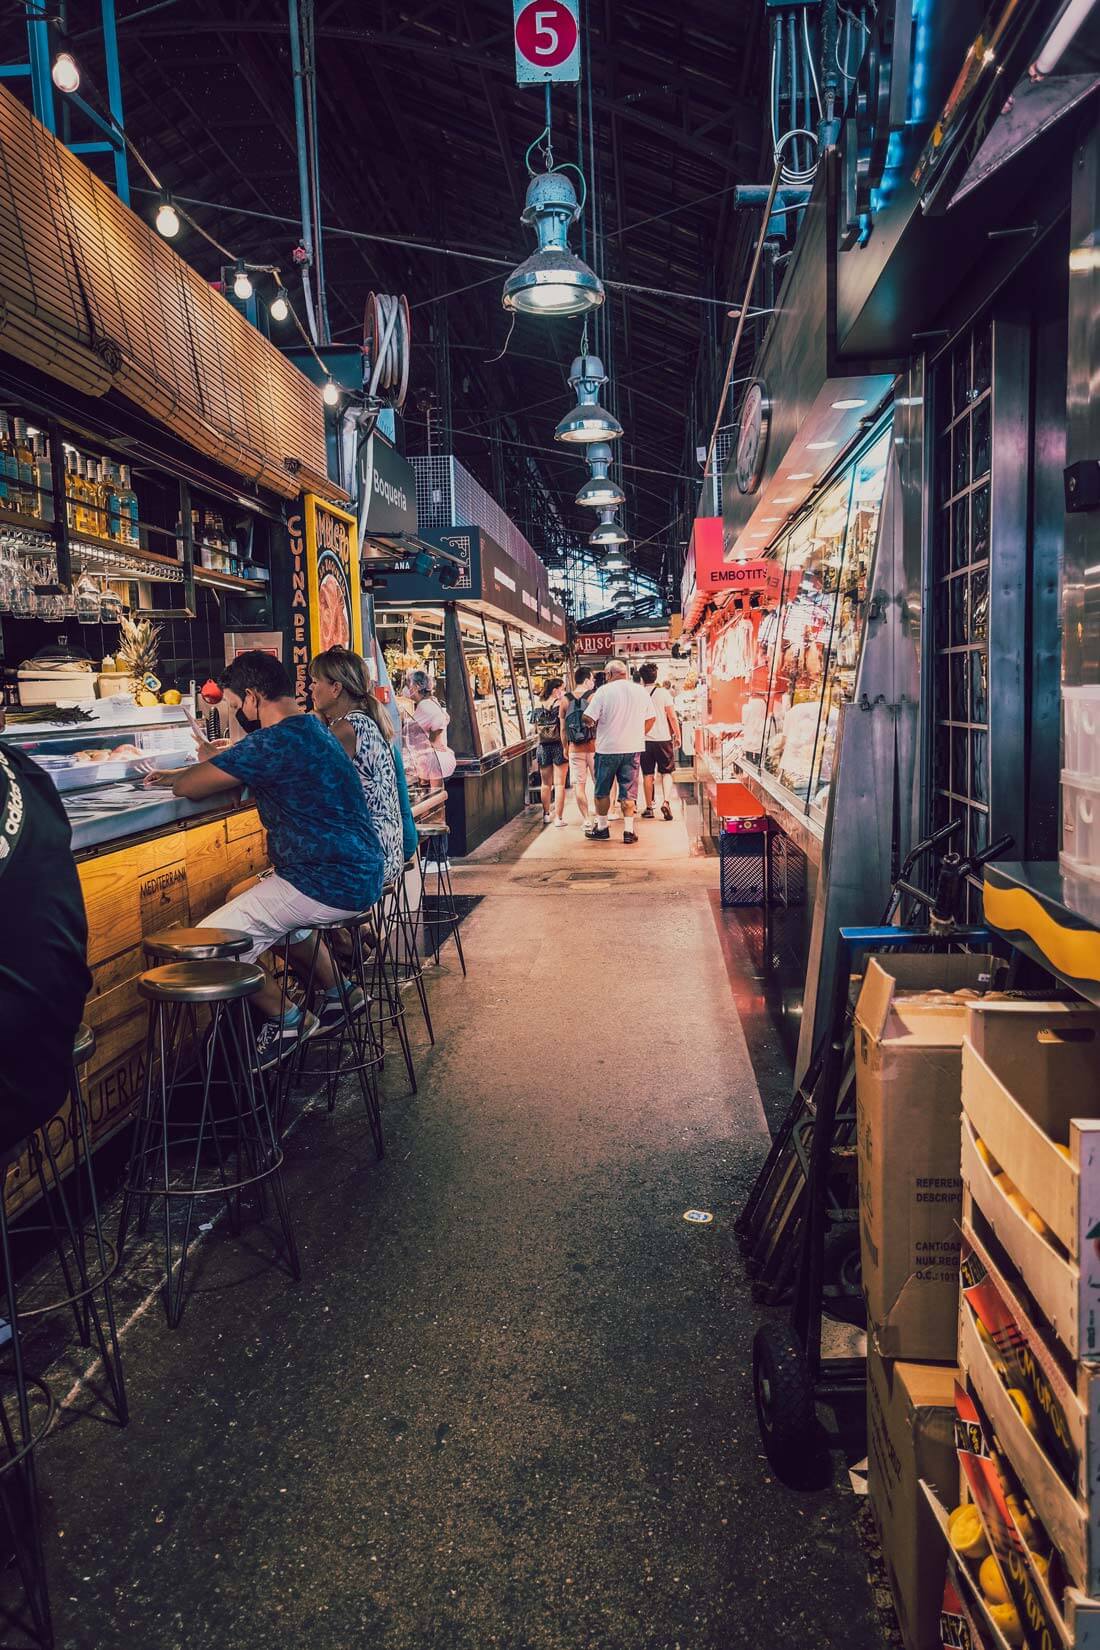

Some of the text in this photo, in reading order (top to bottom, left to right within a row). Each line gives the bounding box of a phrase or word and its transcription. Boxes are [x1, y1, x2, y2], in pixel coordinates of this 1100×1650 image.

[535, 11, 559, 55] 5
[373, 468, 408, 512] Boqueria
[286, 514, 307, 608] CUINA
[293, 613, 306, 642] DE
[4, 779, 24, 836] adidas
[27, 1055, 147, 1176] BOQUERIA
[916, 1177, 963, 1188] REFEREN
